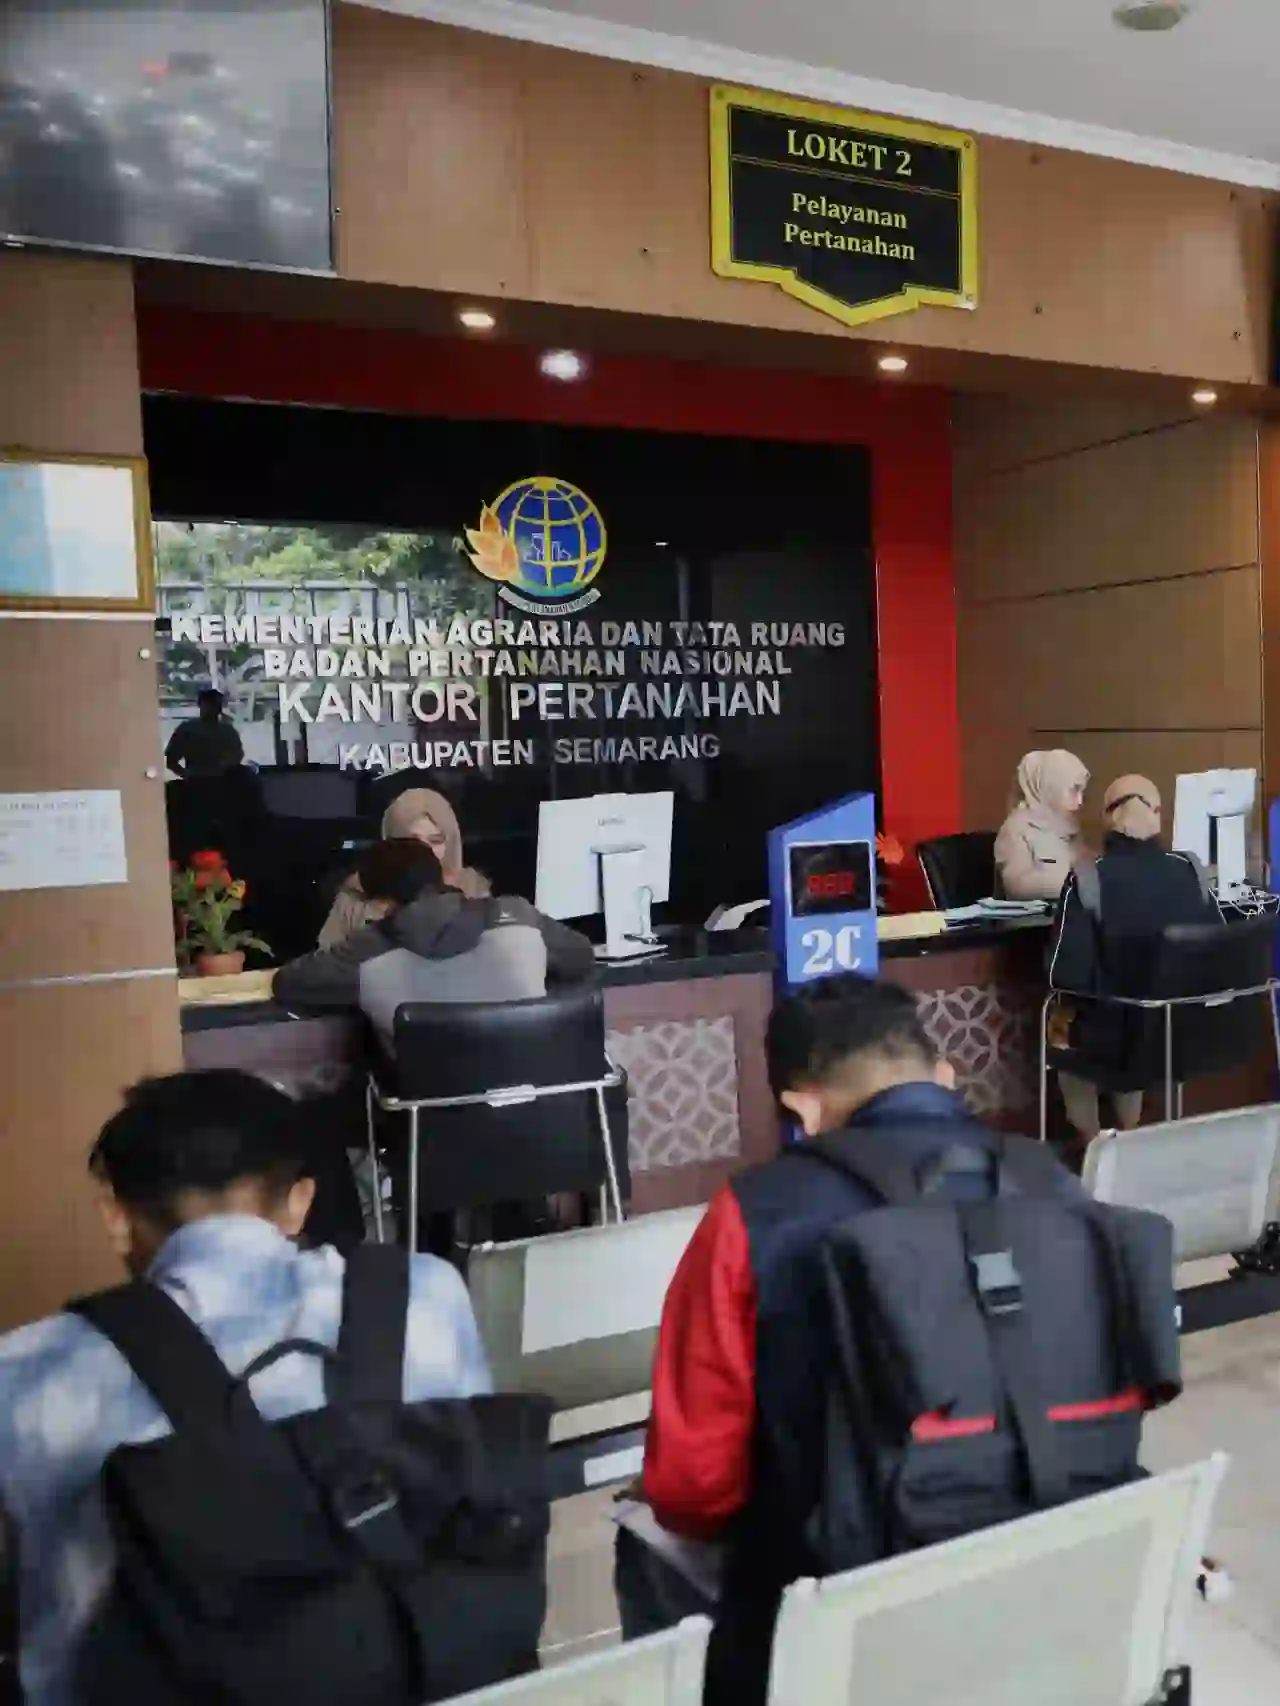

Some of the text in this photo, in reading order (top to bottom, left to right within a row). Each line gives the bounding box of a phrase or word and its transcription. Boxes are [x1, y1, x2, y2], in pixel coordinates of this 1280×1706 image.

[787, 129, 912, 176] LOKET 2
[792, 193, 908, 229] Pelayanan
[784, 223, 915, 260] Pertanahan
[171, 613, 845, 647] KEMENTERIAN AGRARIA DAN TATA RUANG
[263, 648, 792, 678] BADAN PERTANAHAN NASIONAL
[278, 680, 781, 724] KANTOR PERTANAHAN
[337, 733, 721, 773] KABUPATEN SEMARANG
[801, 925, 861, 976] 2C
